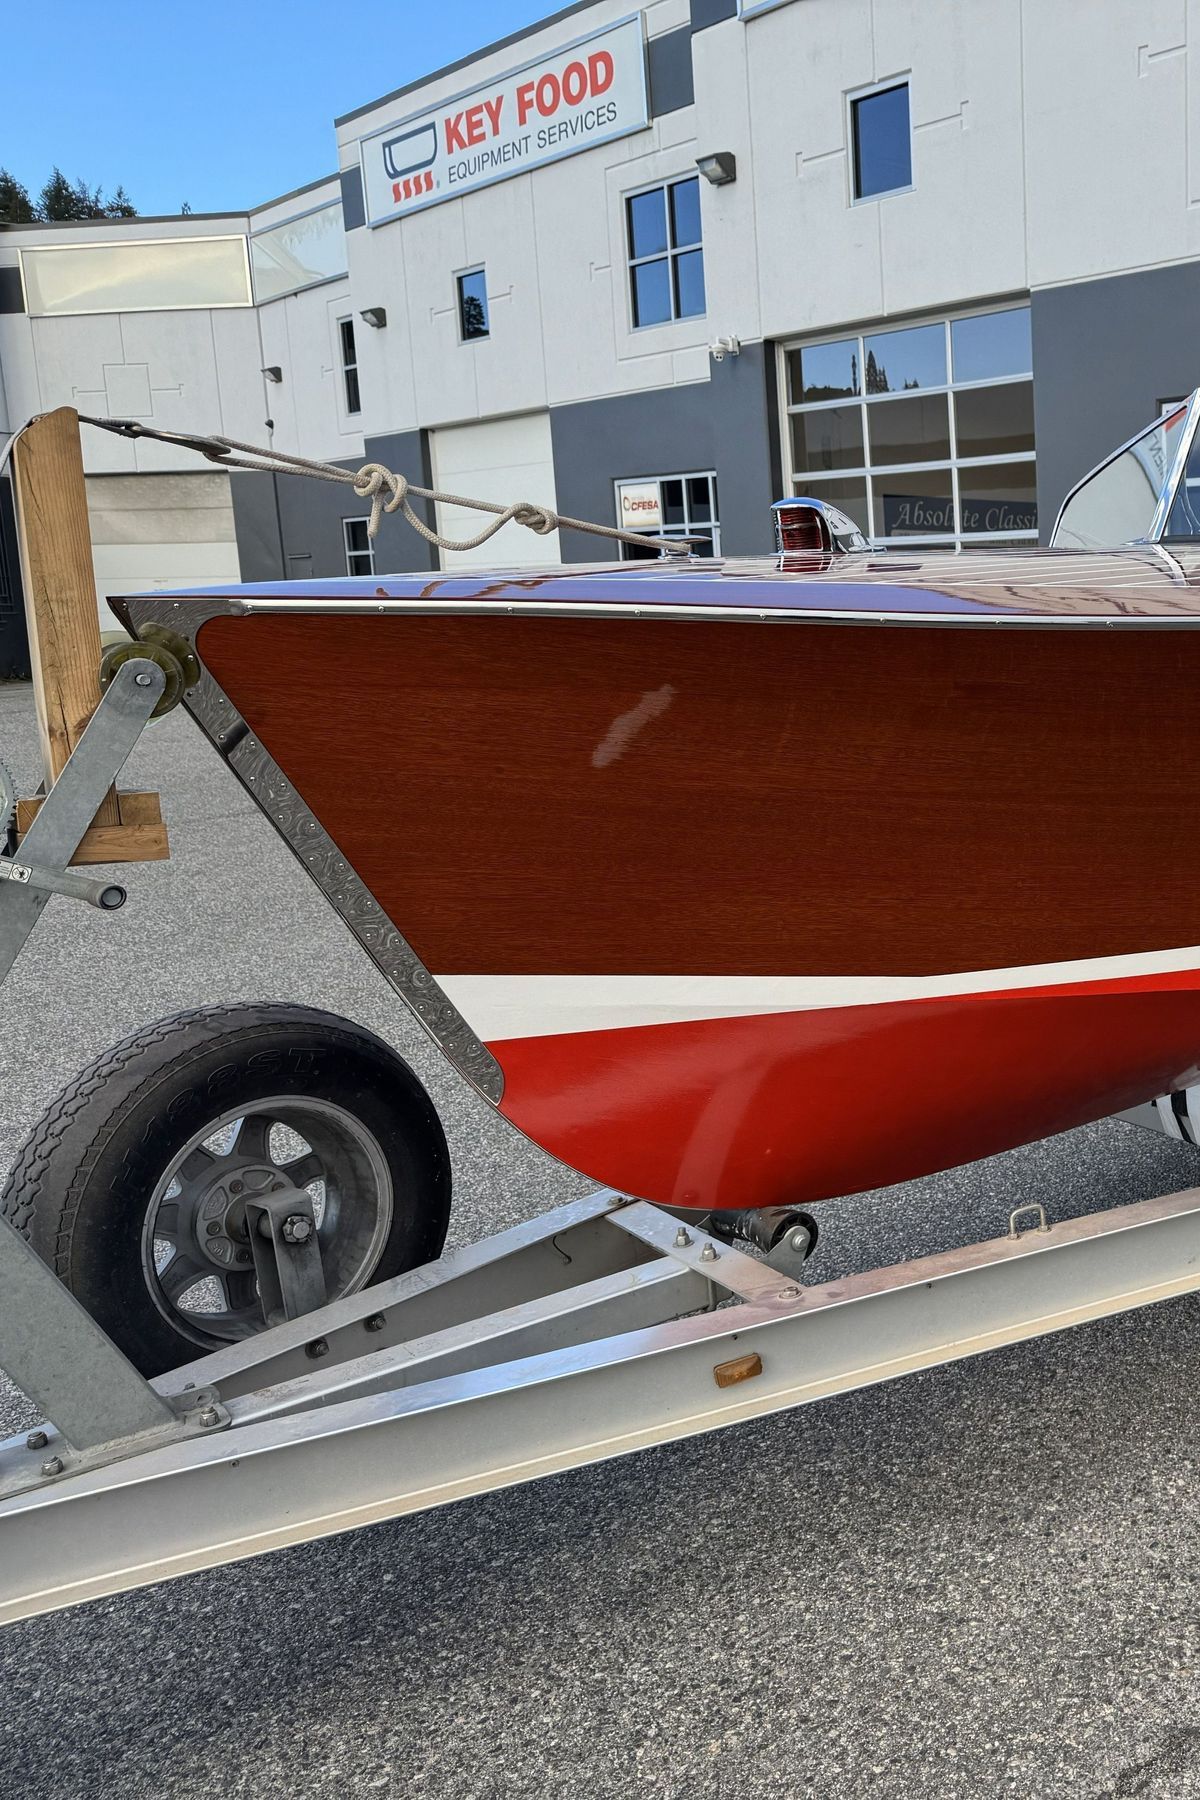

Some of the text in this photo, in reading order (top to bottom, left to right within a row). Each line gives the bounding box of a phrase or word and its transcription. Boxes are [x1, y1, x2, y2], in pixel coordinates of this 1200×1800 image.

[444, 50, 615, 155] KEY FOOD
[448, 102, 617, 184] EQUIPMENT SERVICES
[631, 500, 659, 511] CFESA
[985, 506, 1038, 531] Classi
